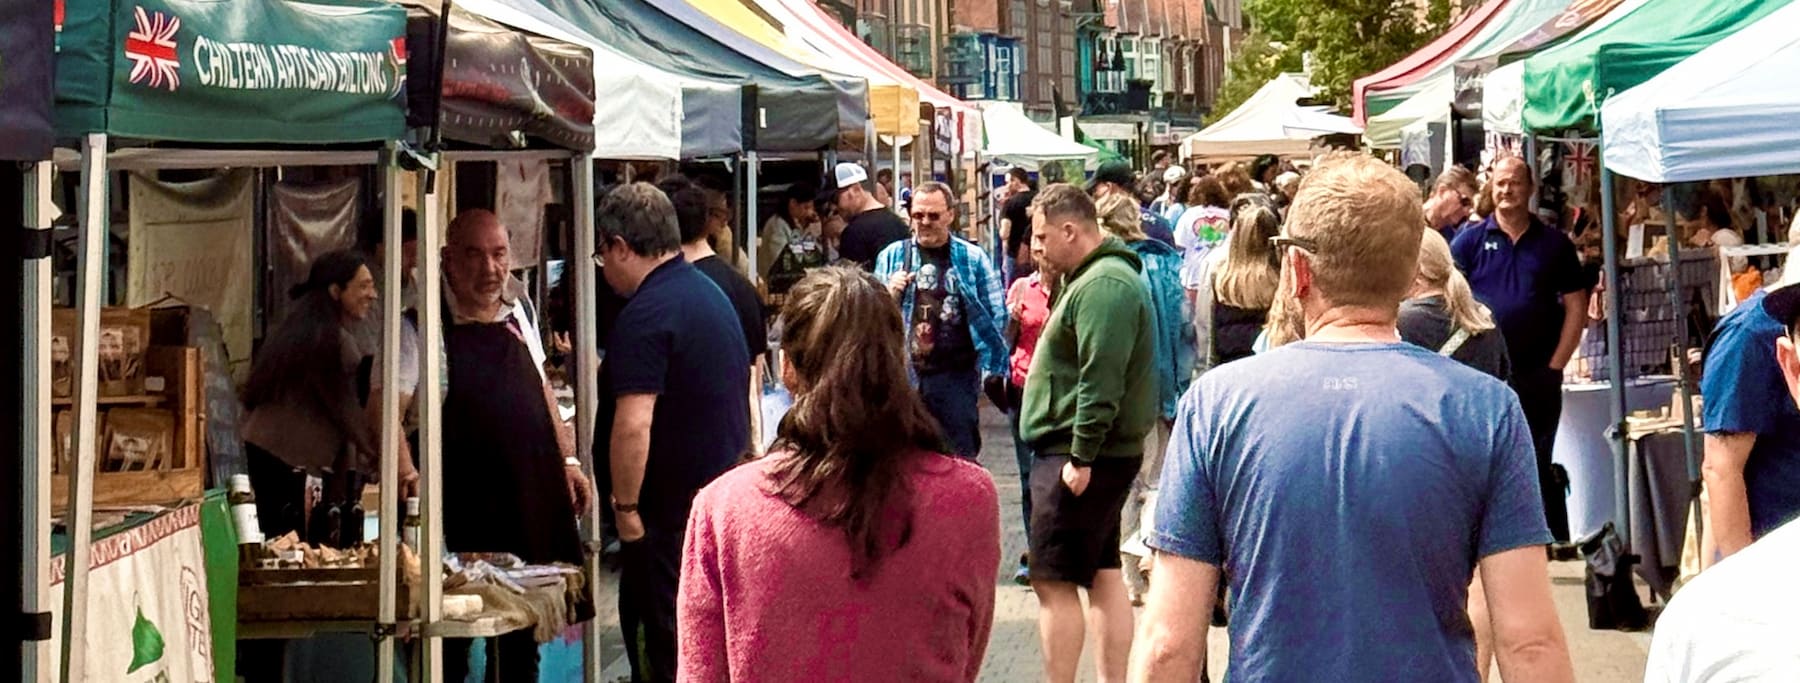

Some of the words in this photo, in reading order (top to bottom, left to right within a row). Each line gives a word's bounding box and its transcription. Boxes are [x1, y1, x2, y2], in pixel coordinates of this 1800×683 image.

[193, 35, 274, 89] CHILTERN
[271, 45, 336, 91] ARTISAN
[329, 52, 387, 94] BILTONG
